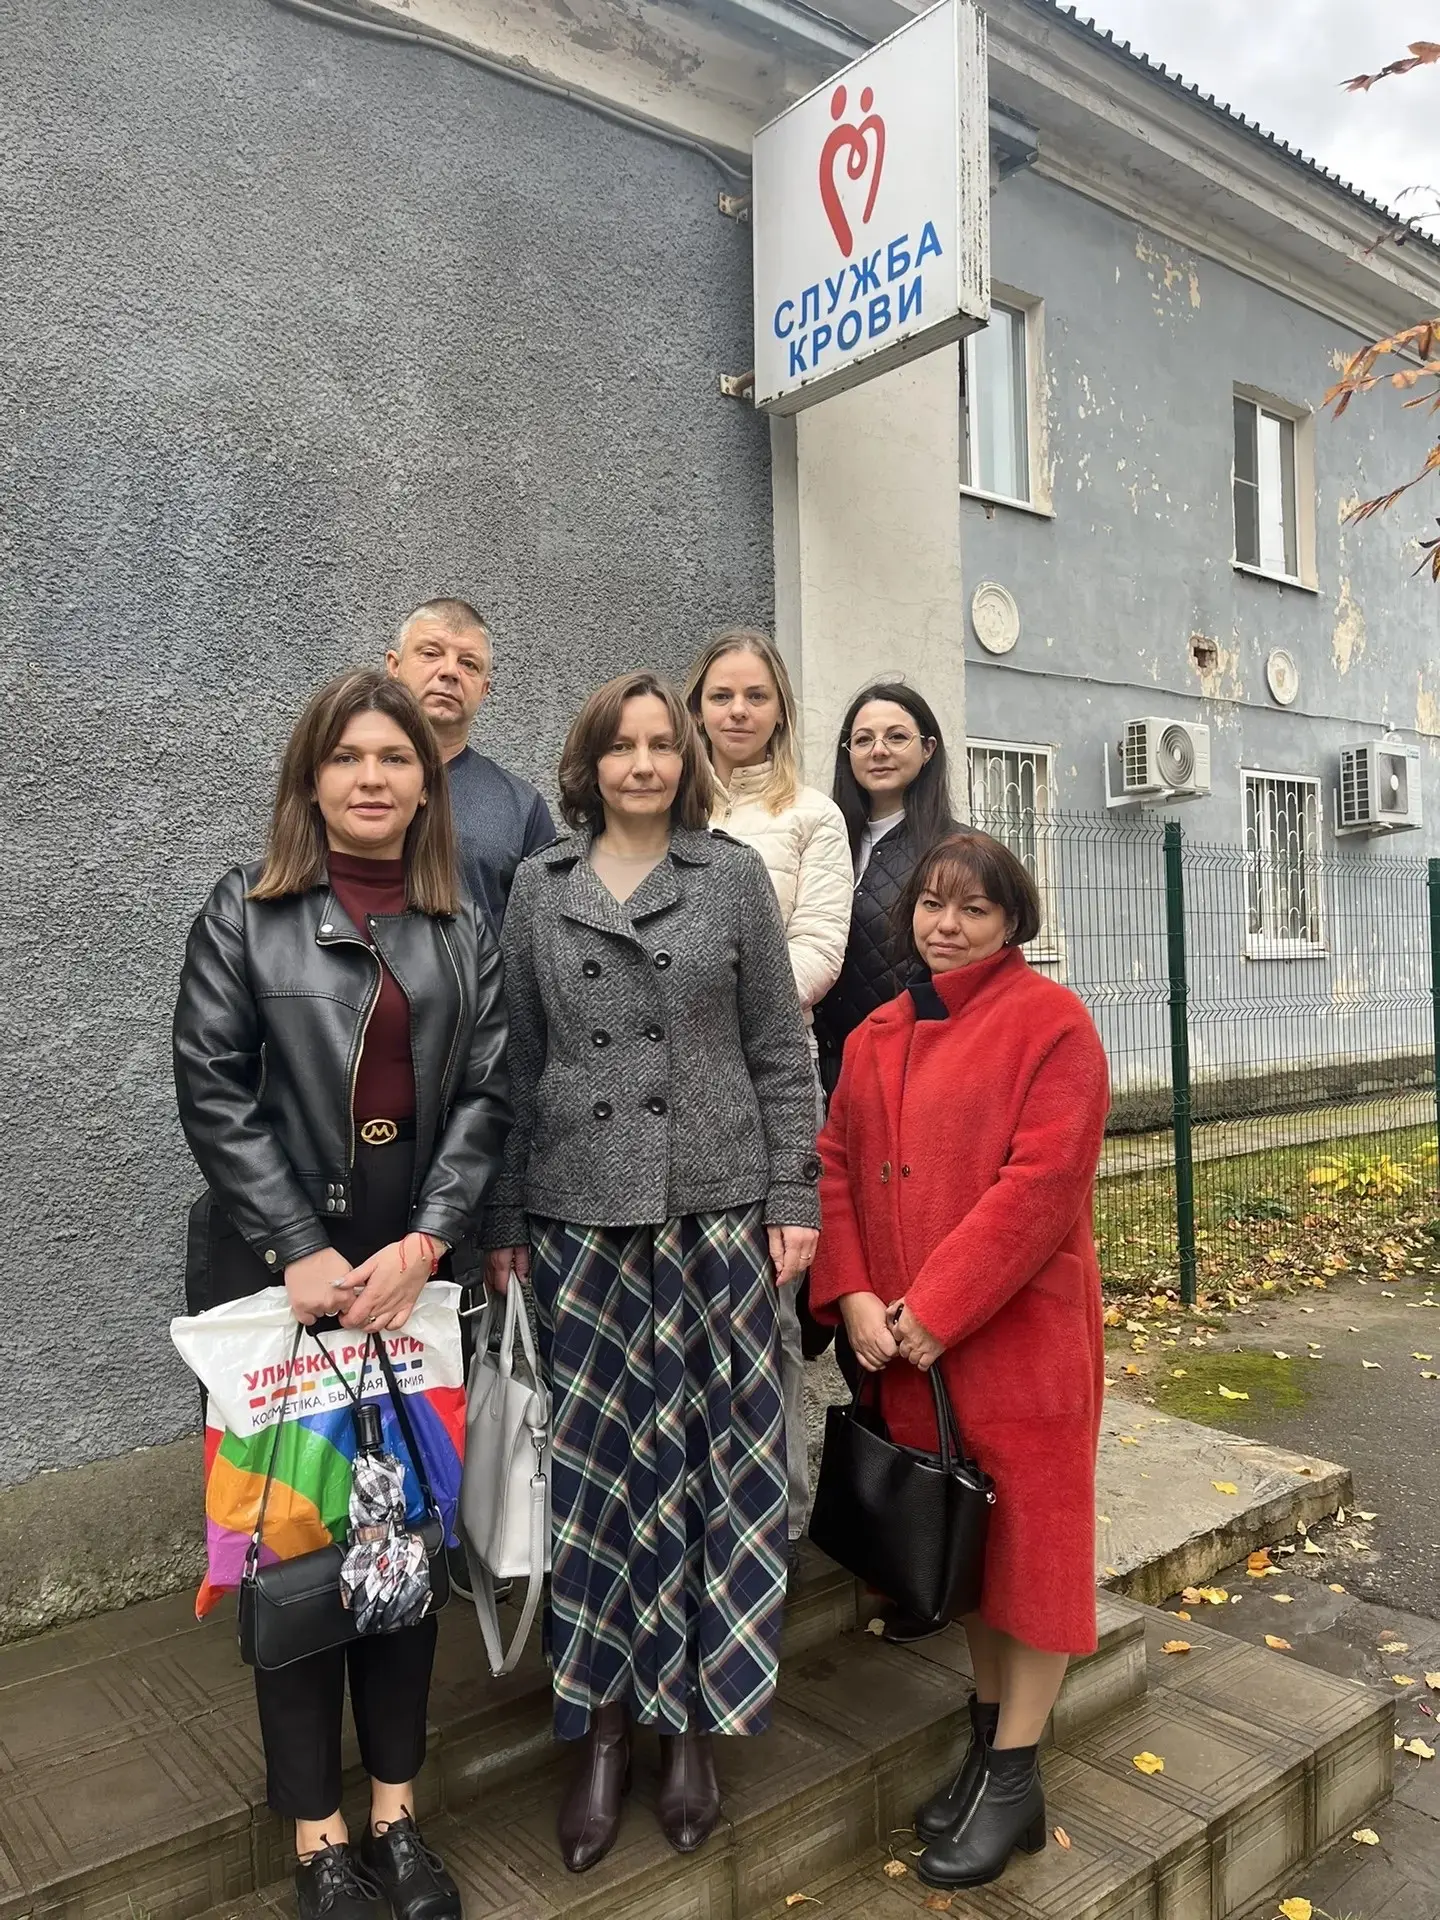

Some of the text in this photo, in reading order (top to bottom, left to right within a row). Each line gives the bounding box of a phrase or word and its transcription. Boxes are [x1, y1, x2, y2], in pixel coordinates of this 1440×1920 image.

[774, 221, 943, 340] СЛУЖБА
[789, 275, 922, 377] КРОВИ
[387, 1373, 425, 1390] ИМИЯ
